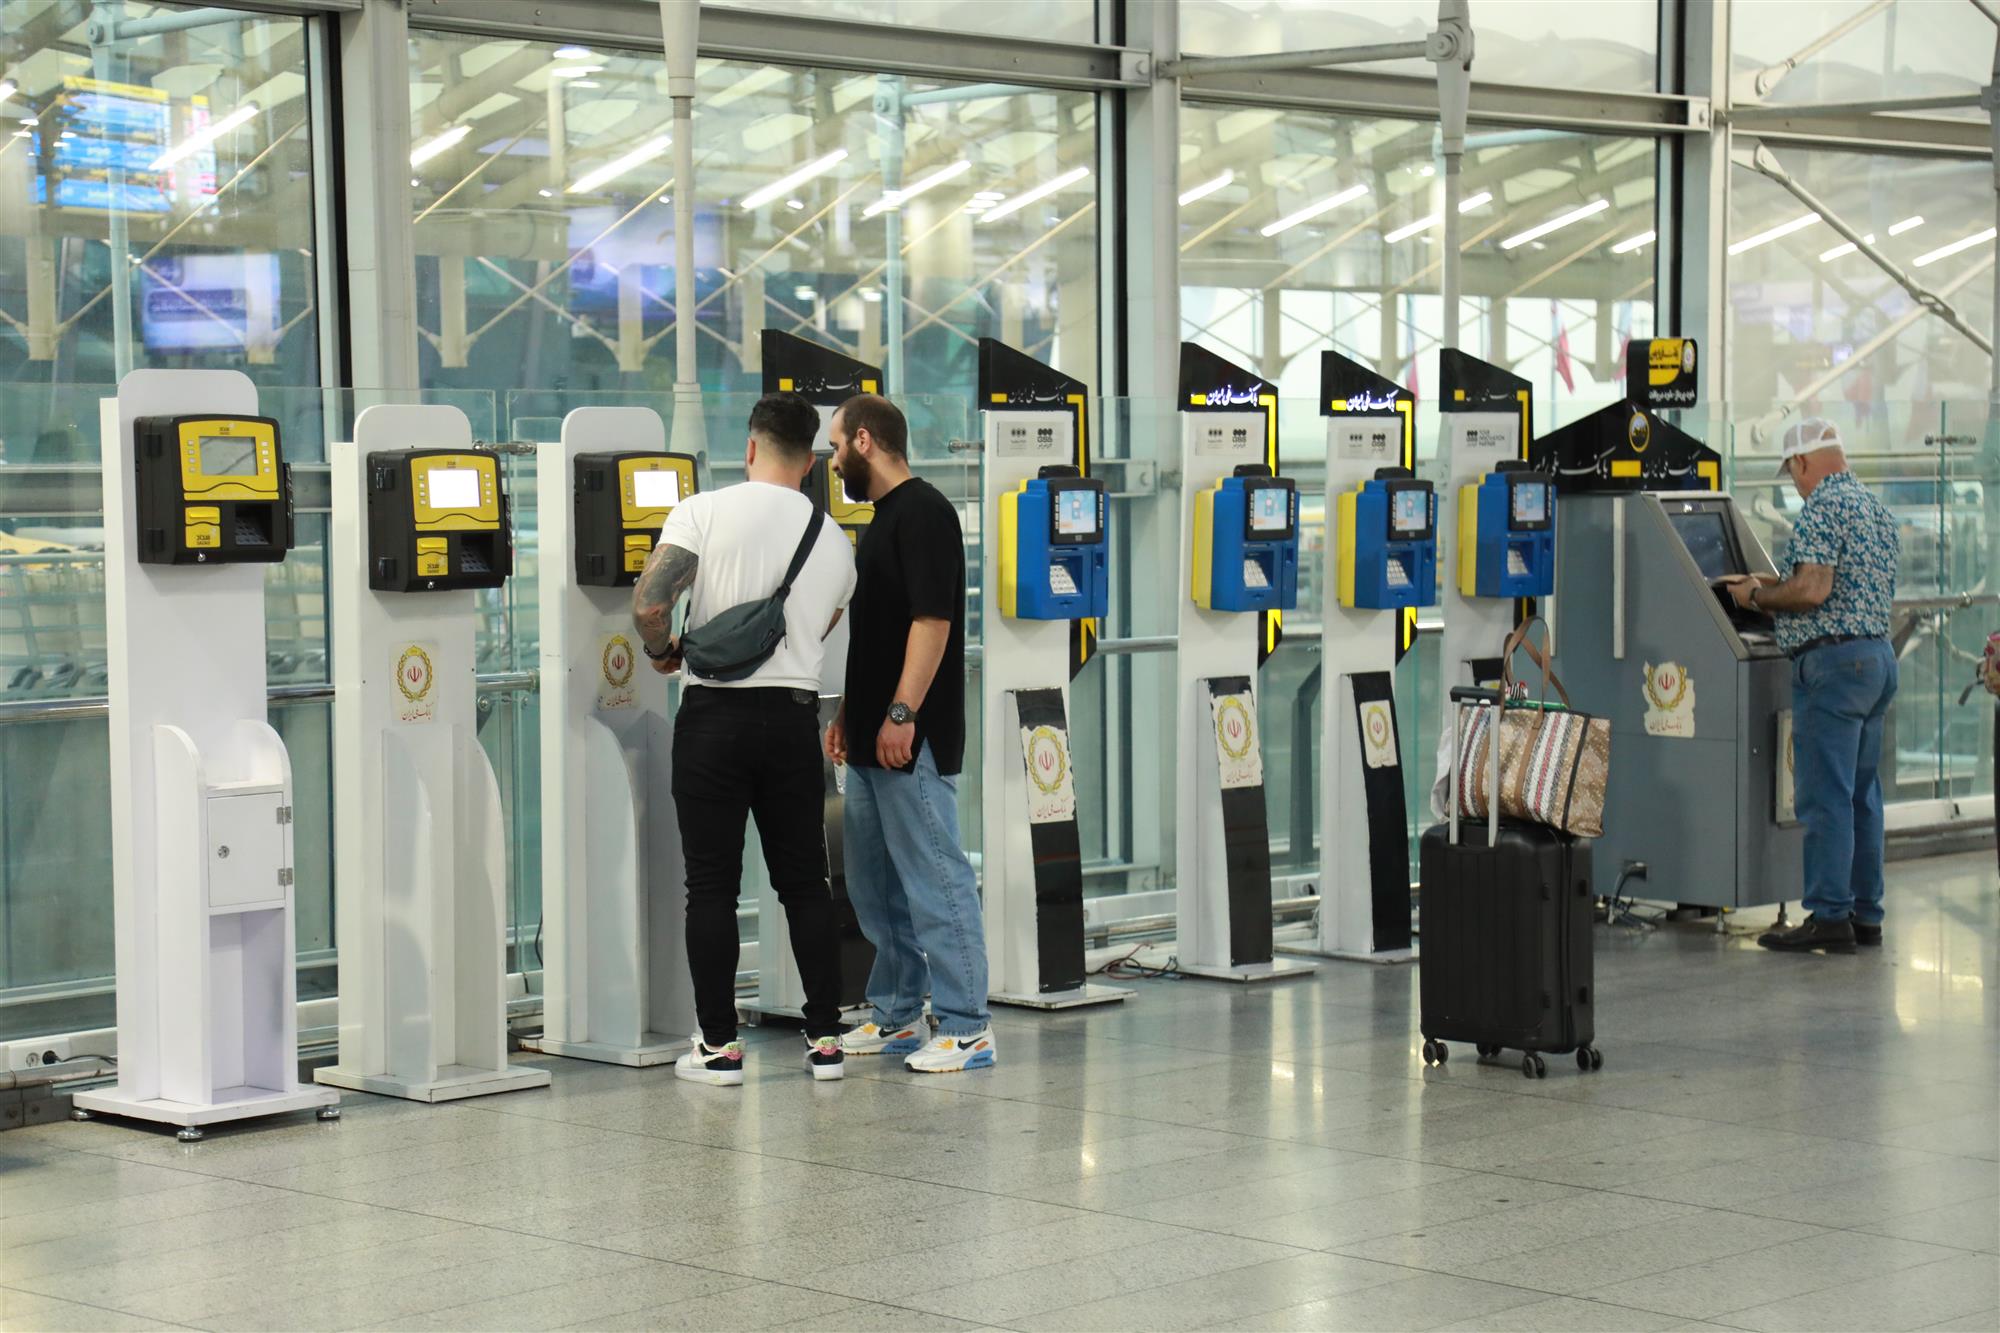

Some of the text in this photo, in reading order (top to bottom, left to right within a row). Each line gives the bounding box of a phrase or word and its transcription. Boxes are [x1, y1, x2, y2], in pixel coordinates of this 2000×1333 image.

[1206, 388, 1224, 406] ایران
[1230, 383, 1262, 407] بانک
[1345, 394, 1363, 412] ایران
[1368, 389, 1399, 413] بانک
